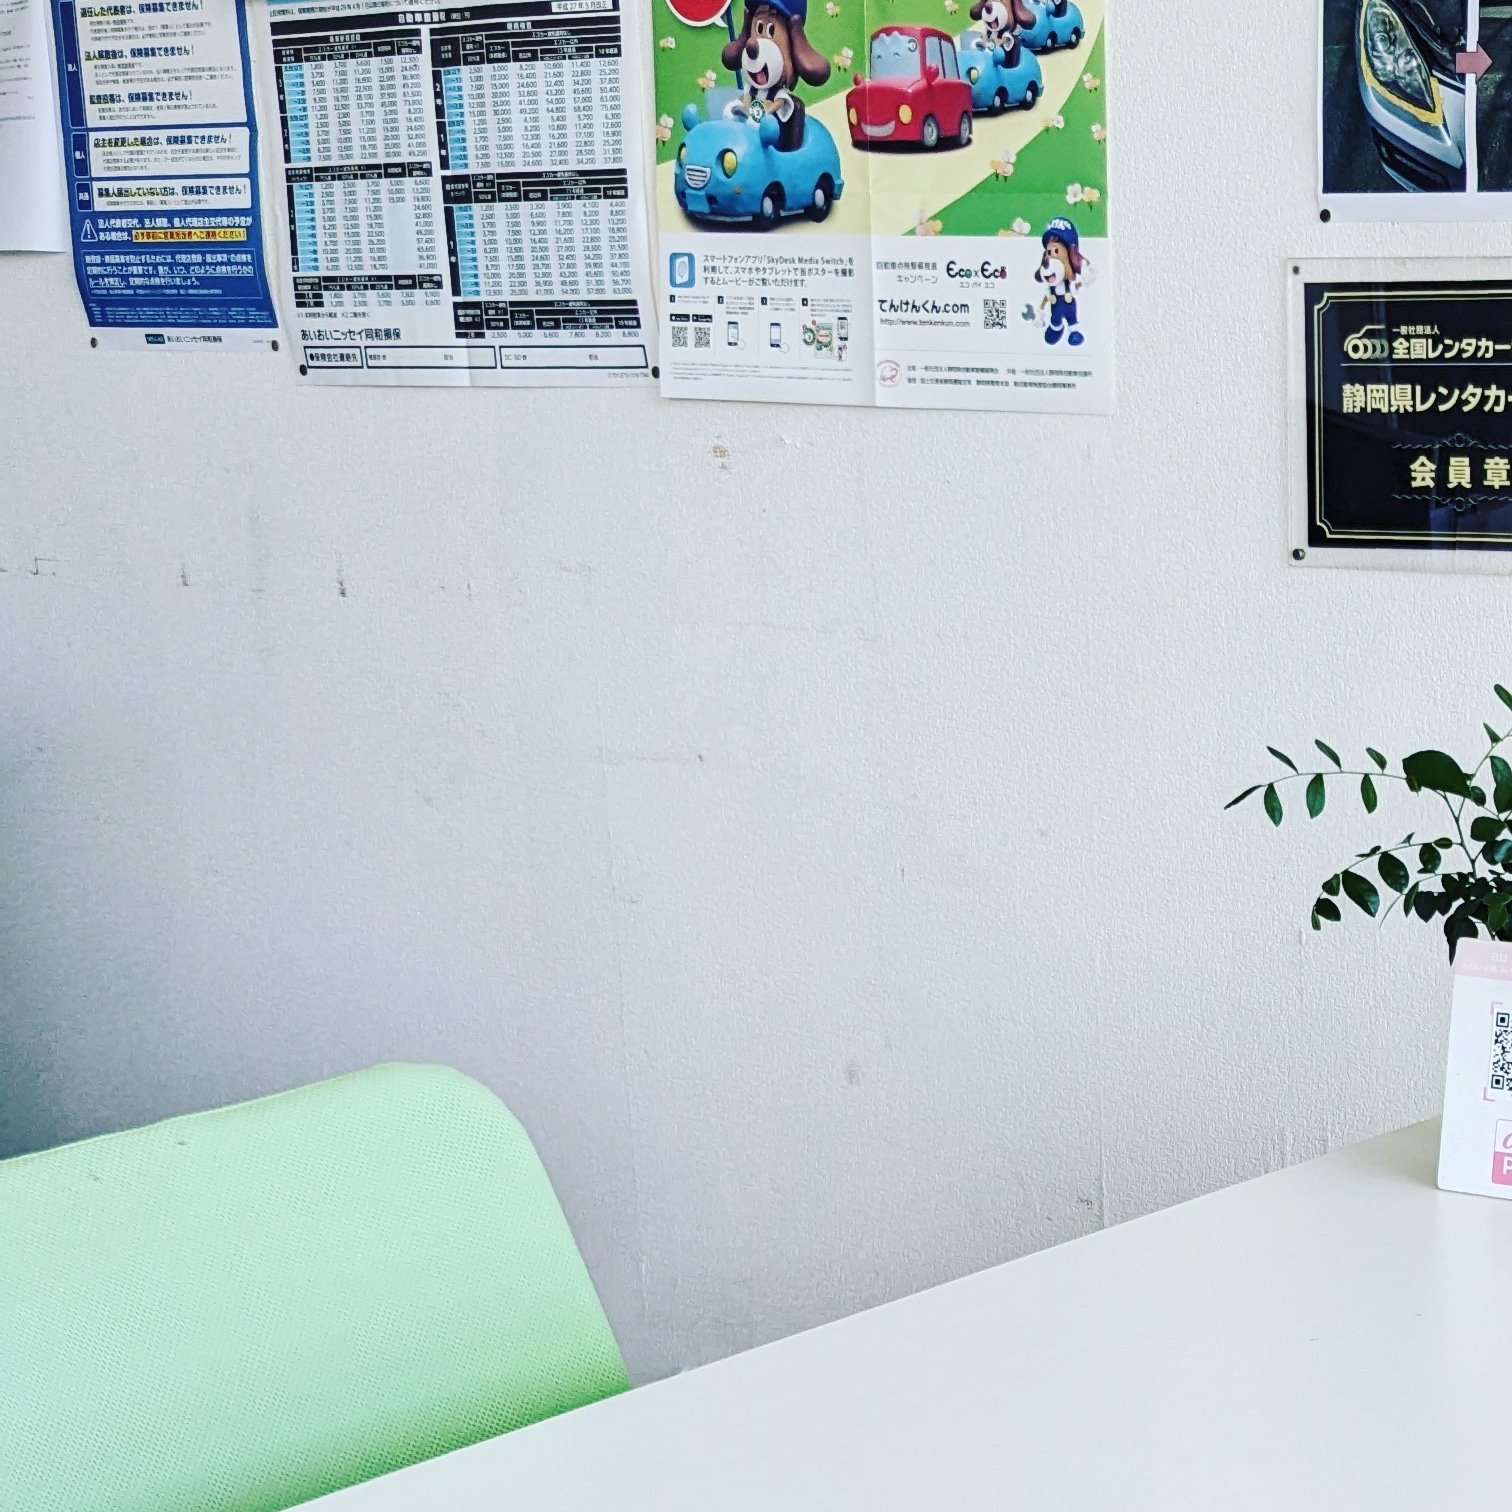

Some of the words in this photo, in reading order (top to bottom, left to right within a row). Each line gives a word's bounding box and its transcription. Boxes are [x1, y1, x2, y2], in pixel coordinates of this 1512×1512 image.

[897, 275, 938, 284] キャンペーン
[1392, 325, 1440, 335] 一般社団法人
[1410, 456, 1511, 489] 会員章
